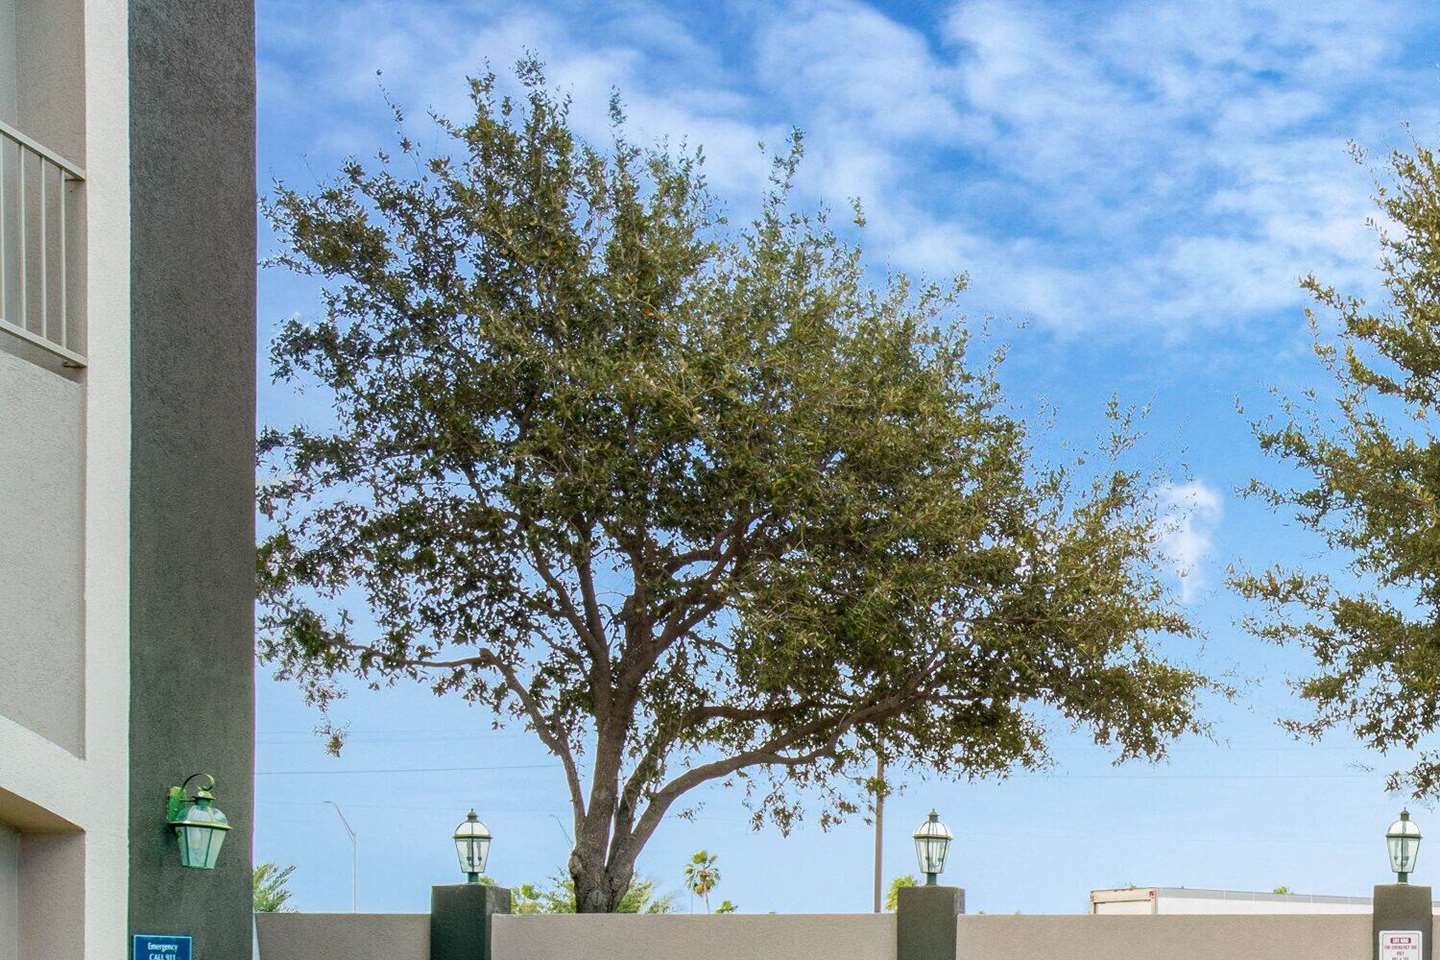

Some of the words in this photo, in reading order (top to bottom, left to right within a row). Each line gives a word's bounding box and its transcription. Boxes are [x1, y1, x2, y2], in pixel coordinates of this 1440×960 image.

[147, 942, 178, 952] Emergency
[149, 953, 164, 960] CALL
[165, 953, 176, 960] 911
